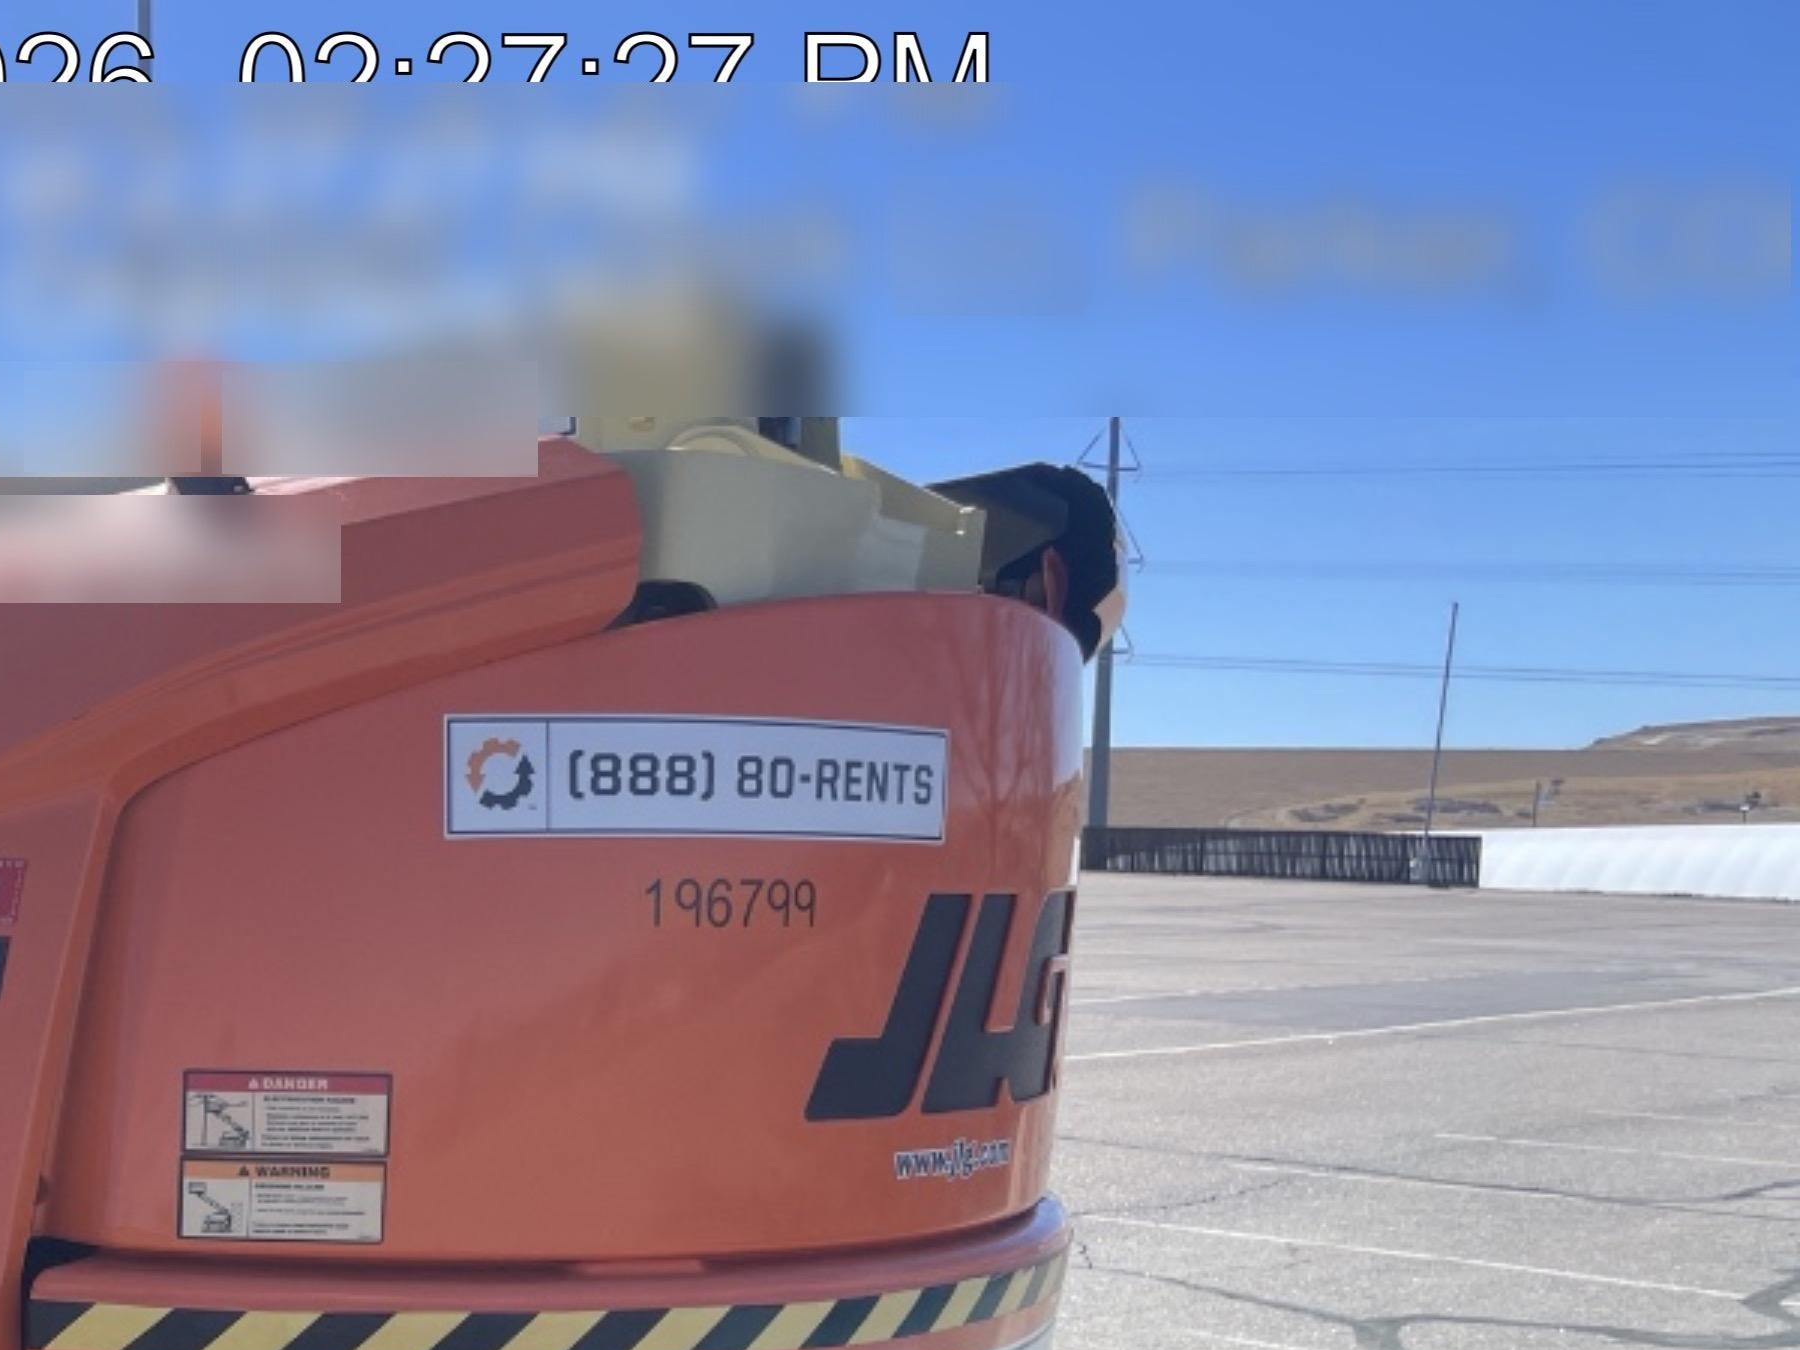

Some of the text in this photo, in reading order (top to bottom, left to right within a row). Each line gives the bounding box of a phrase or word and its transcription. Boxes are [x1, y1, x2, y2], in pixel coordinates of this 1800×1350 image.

[568, 749, 934, 806] (888) 80-RENTS
[646, 878, 817, 928] 196799
[804, 889, 1077, 1122] JLG
